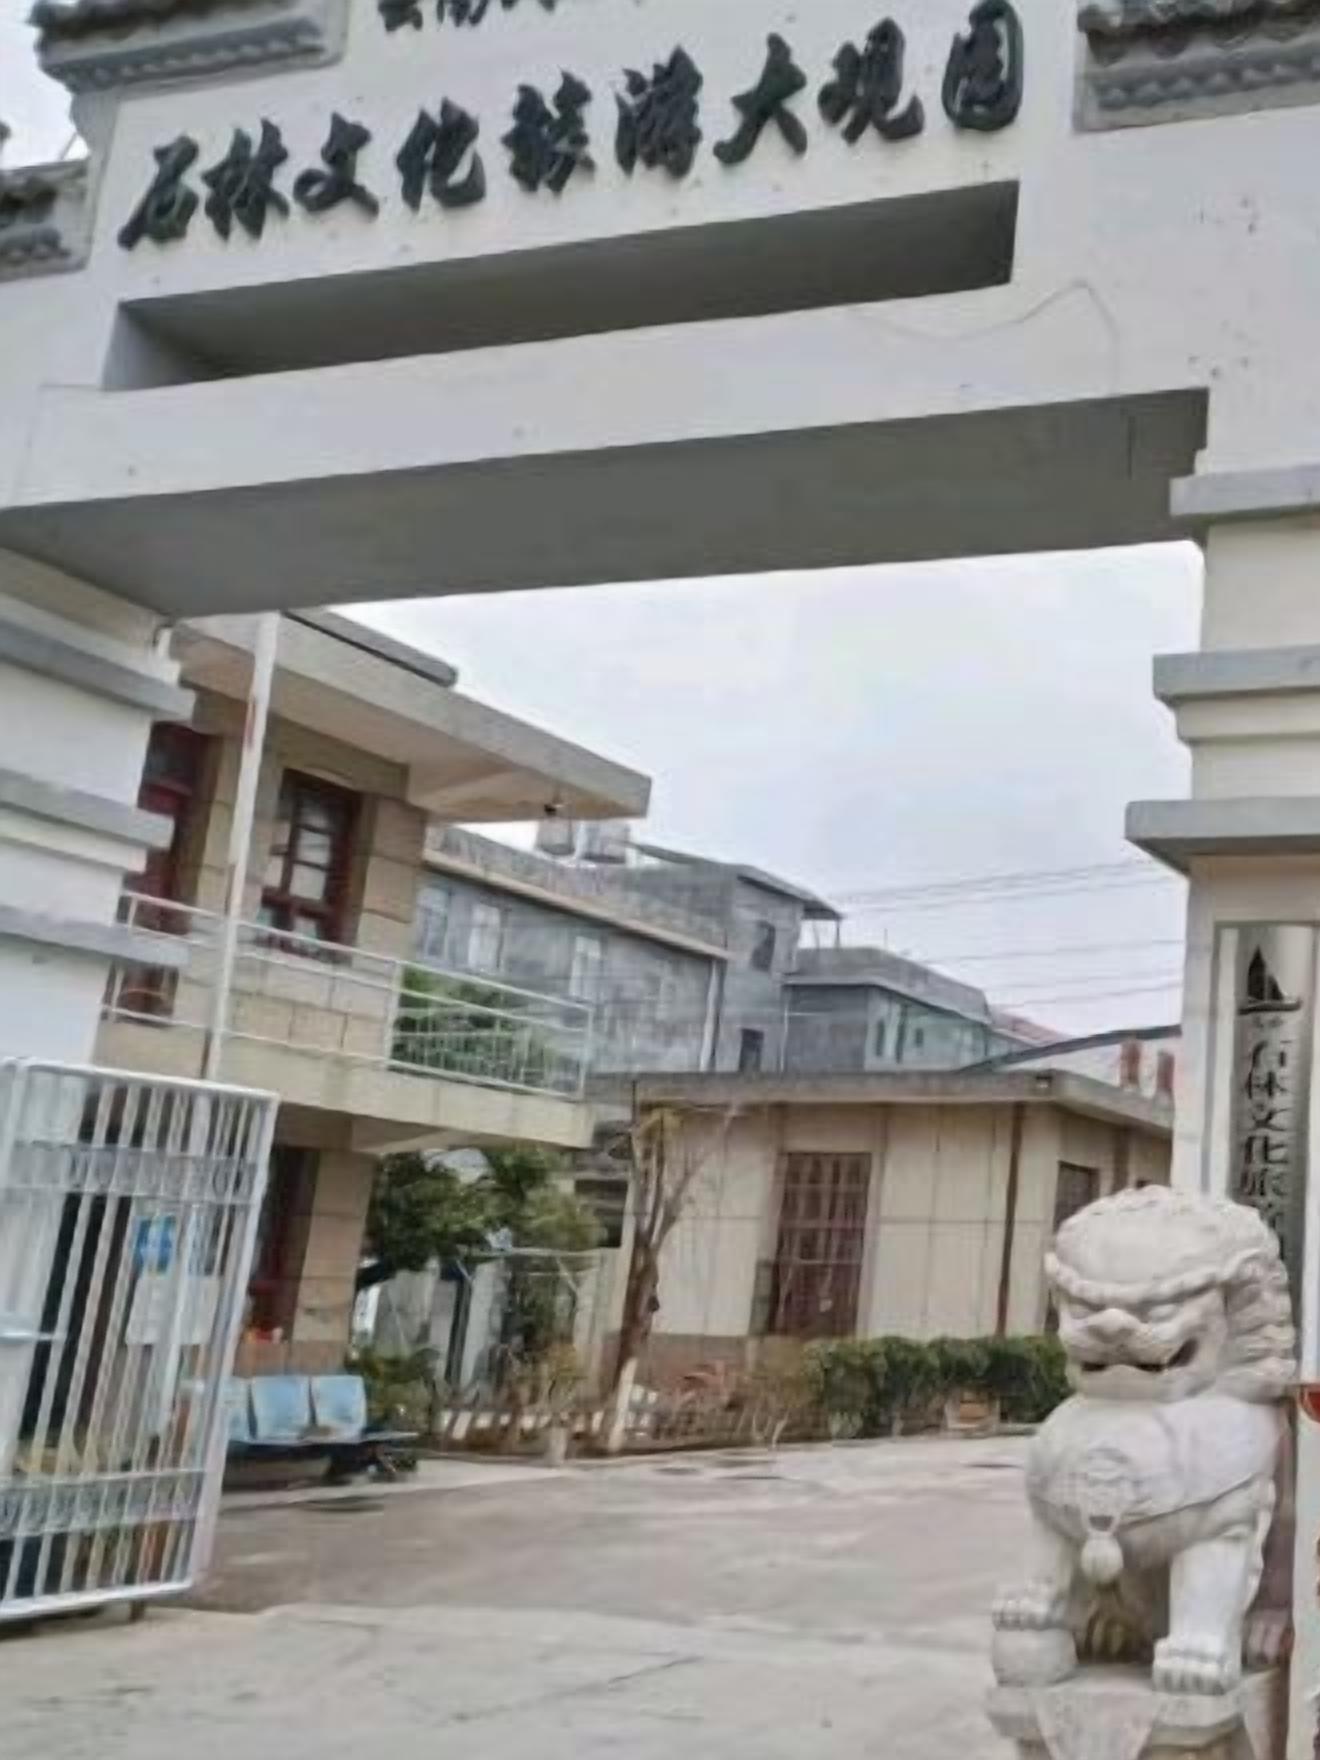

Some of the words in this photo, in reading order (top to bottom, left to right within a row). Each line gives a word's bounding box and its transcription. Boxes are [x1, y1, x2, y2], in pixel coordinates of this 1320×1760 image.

[117, 0, 1024, 250] 石林文化旅游大观园
